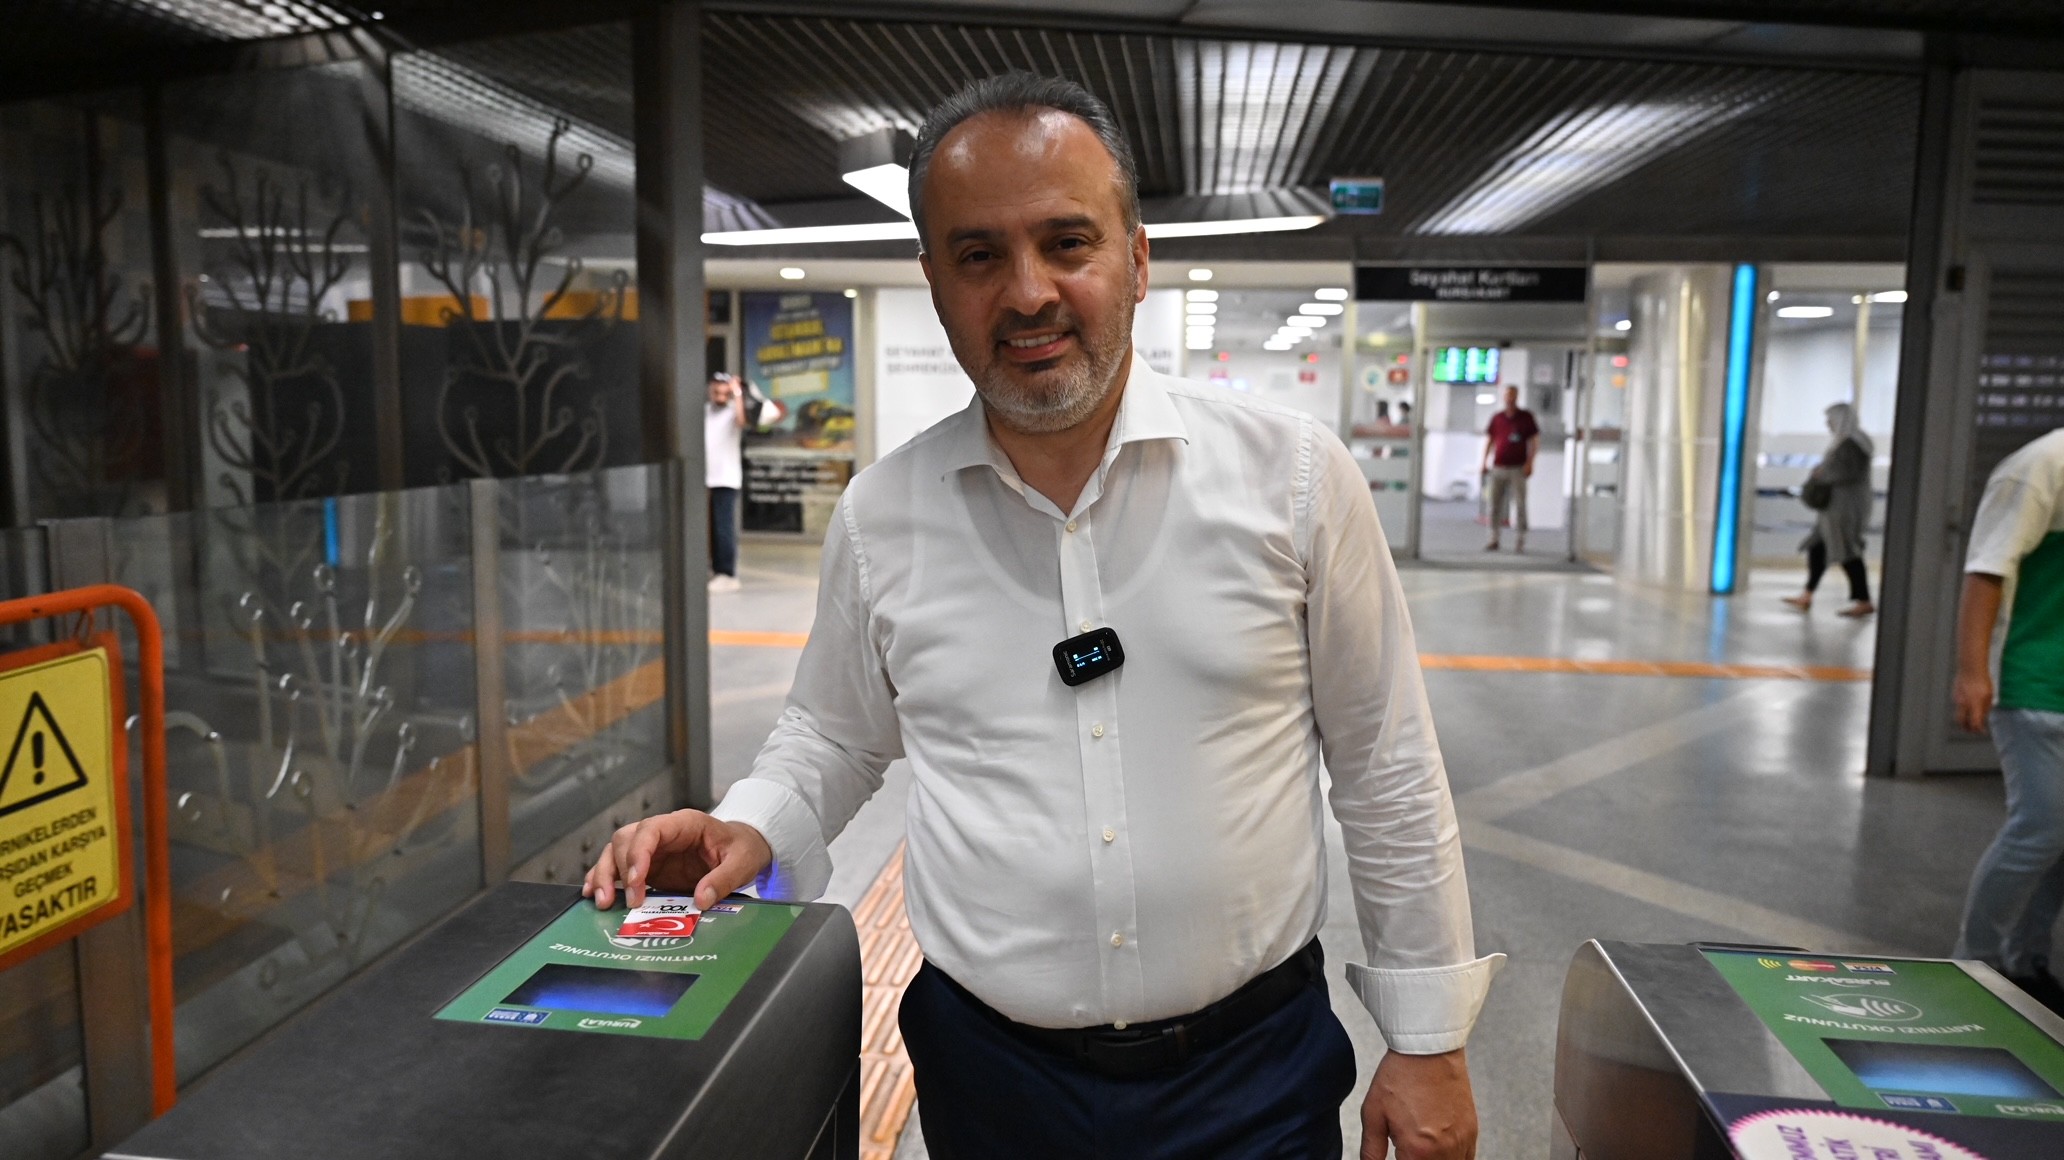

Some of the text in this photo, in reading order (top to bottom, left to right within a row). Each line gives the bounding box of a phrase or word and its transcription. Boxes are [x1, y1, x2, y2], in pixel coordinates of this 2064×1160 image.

[549, 943, 718, 962] KARTINIZI OKUTUNUZ
[1783, 1013, 1986, 1034] KARTINIZI OKUTUNUZ
